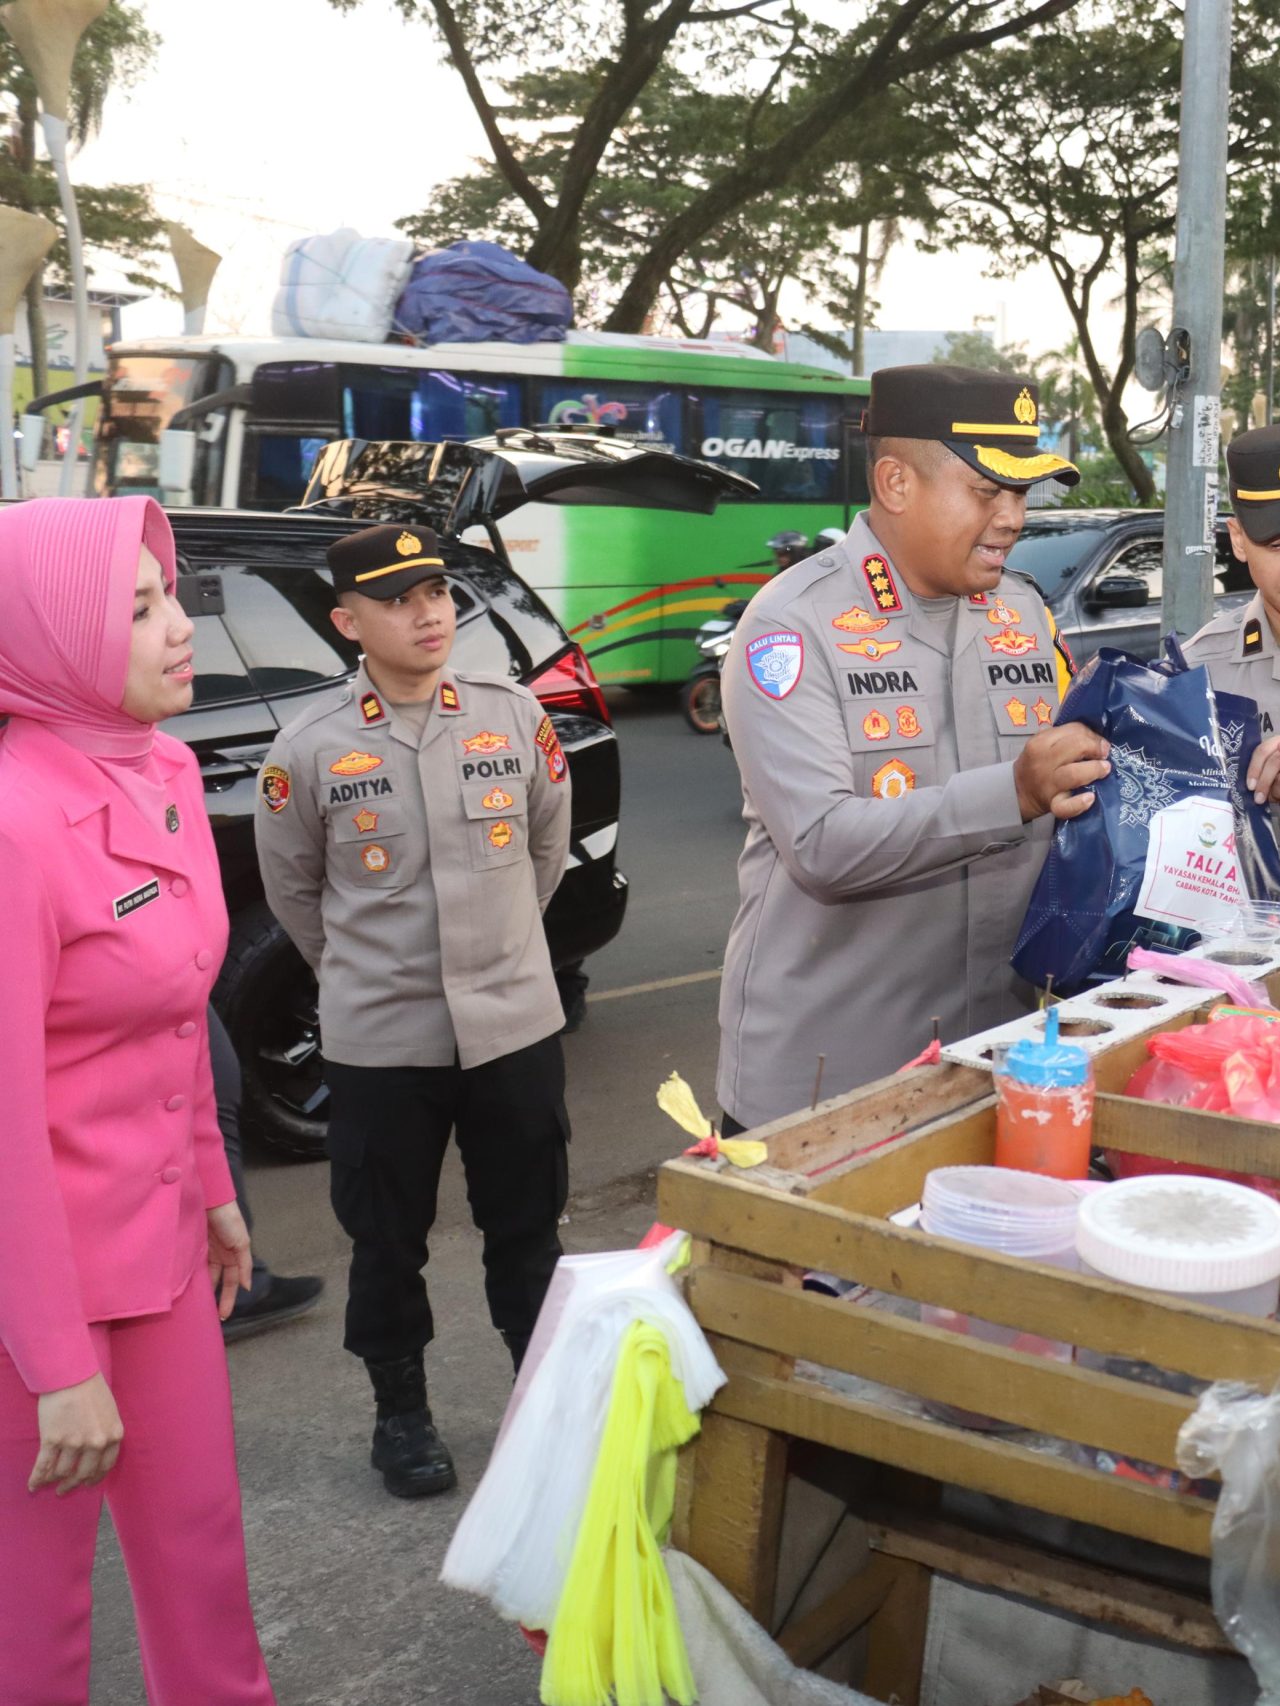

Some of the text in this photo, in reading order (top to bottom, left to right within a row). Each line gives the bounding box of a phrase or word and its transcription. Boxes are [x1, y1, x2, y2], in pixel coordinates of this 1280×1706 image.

[701, 437, 840, 462] OGAN Express
[749, 634, 797, 653] LALU LINTAS
[847, 670, 919, 695] INDRA
[987, 662, 1054, 686] POLRI
[462, 757, 522, 781] POLRI
[329, 777, 393, 805] ADITYA
[1222, 831, 1237, 856] 4
[1186, 850, 1224, 876] TALI
[1163, 864, 1197, 881] YAYASAN
[1197, 875, 1226, 890] KEMALA
[1175, 880, 1201, 893] CABANG
[1201, 887, 1218, 897] KOTA
